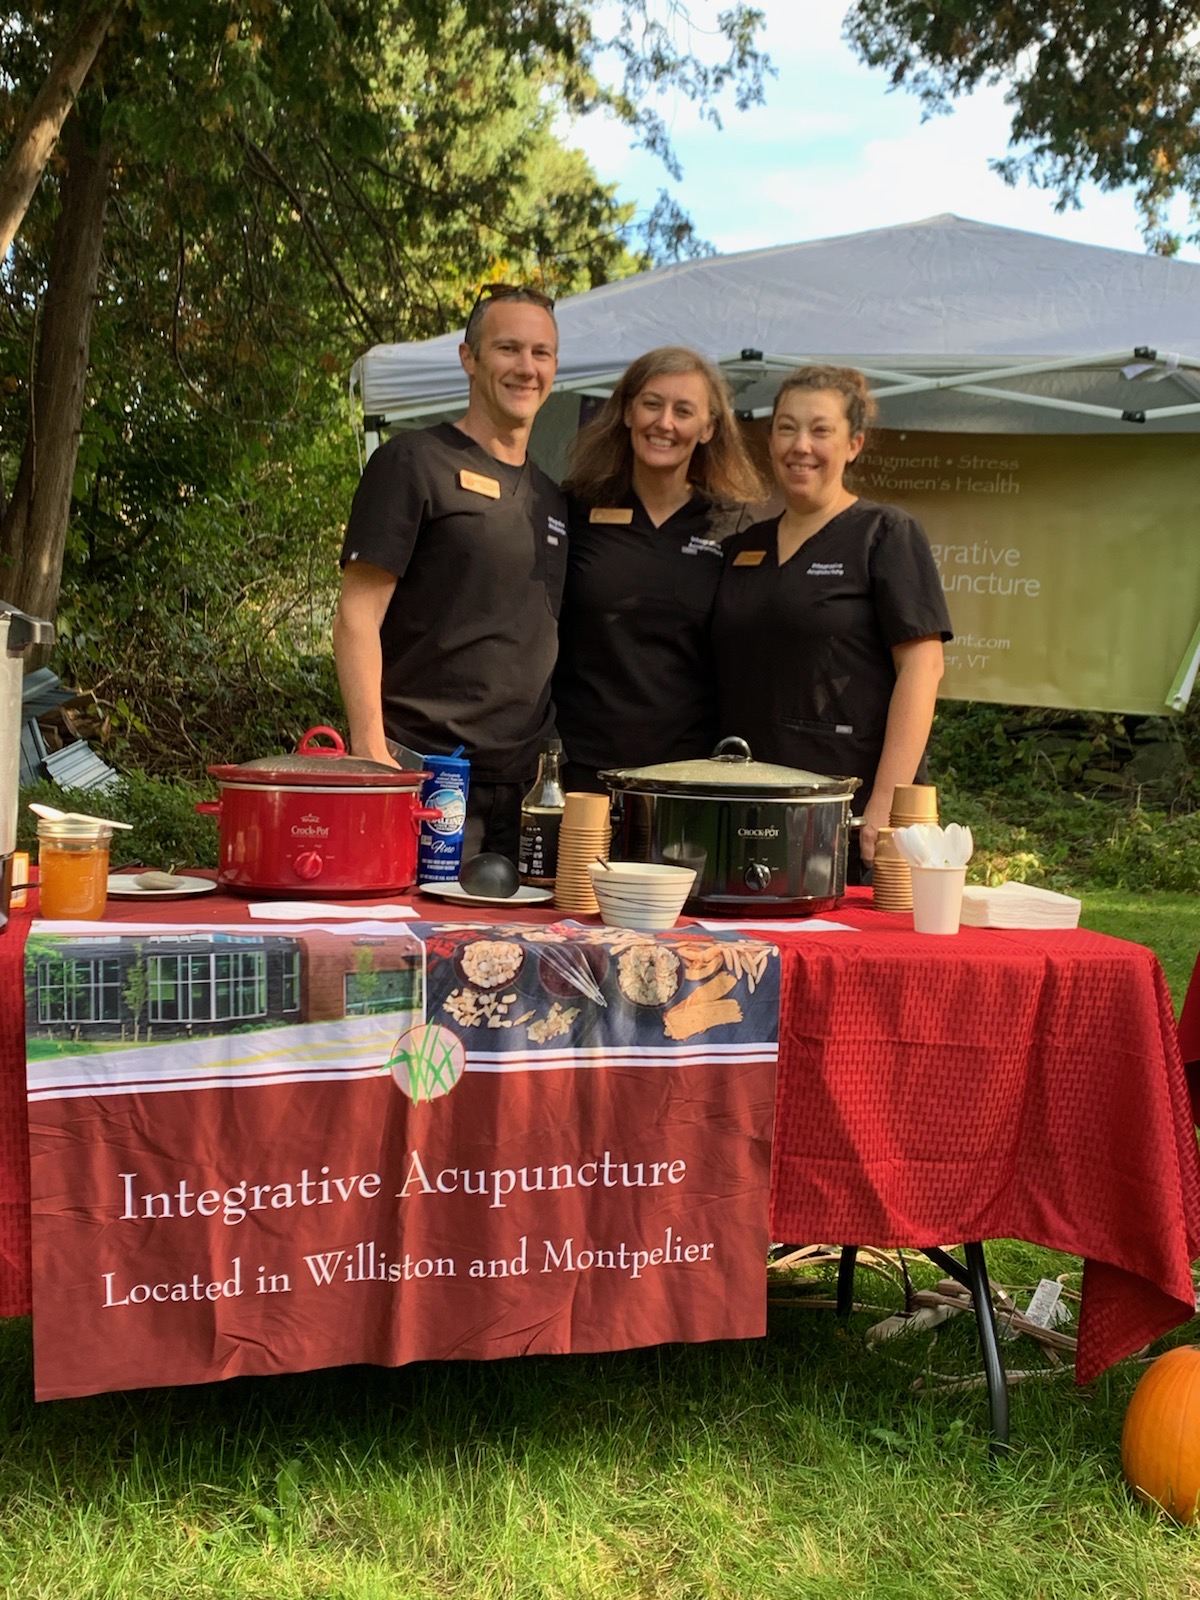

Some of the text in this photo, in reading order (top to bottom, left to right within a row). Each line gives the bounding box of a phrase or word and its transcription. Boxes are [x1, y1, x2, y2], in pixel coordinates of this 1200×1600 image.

[857, 454, 1020, 473] nagment Stress
[870, 473, 1020, 494] Women's Health
[930, 540, 1021, 568] grative
[940, 572, 1041, 597] uncture
[943, 633, 1011, 649] ont.com
[967, 654, 991, 668] VT
[430, 839, 456, 854] Fine
[117, 1149, 687, 1227] Integrative Acupuncture
[101, 1225, 715, 1309] Located in Williston and Montpelier
